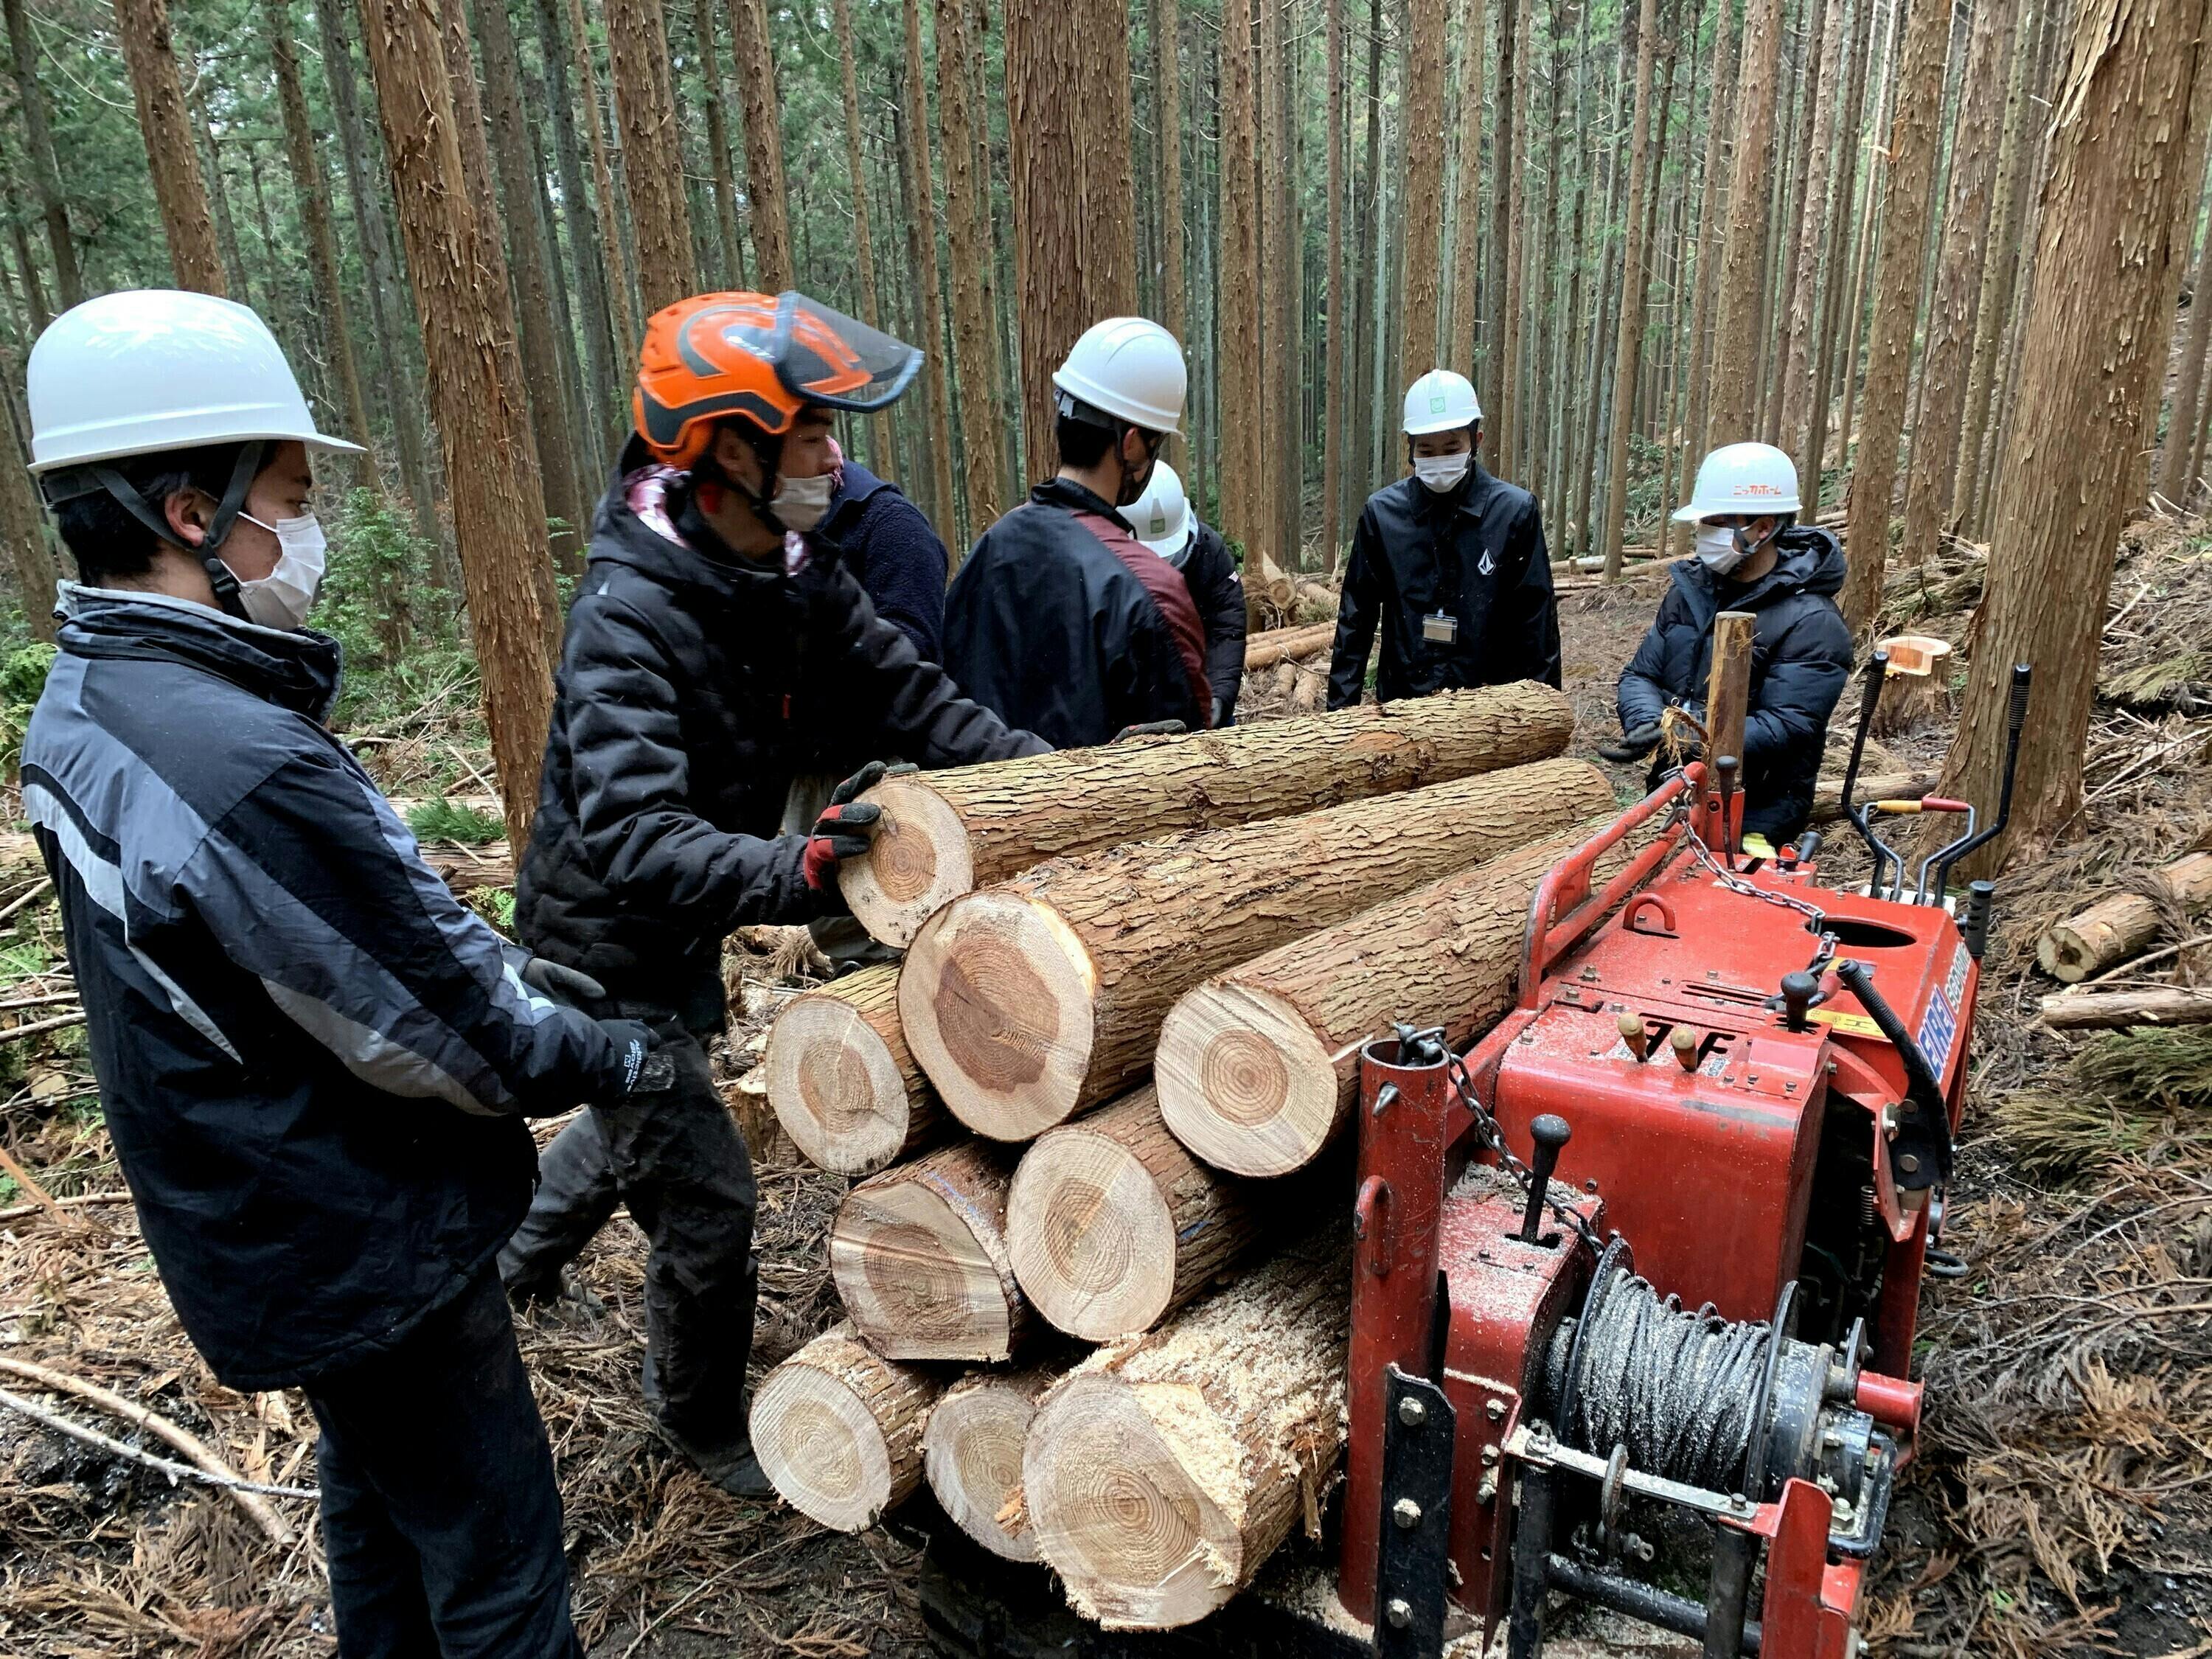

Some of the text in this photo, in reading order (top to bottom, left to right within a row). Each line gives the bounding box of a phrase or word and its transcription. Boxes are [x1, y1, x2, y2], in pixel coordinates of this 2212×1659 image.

[1733, 485, 1781, 495] ニッカホーム
[1916, 984, 1957, 1085] EIREI
[625, 1055, 631, 1067] M
[625, 1041, 637, 1084] Gloves
[627, 1040, 642, 1092] Addictive
